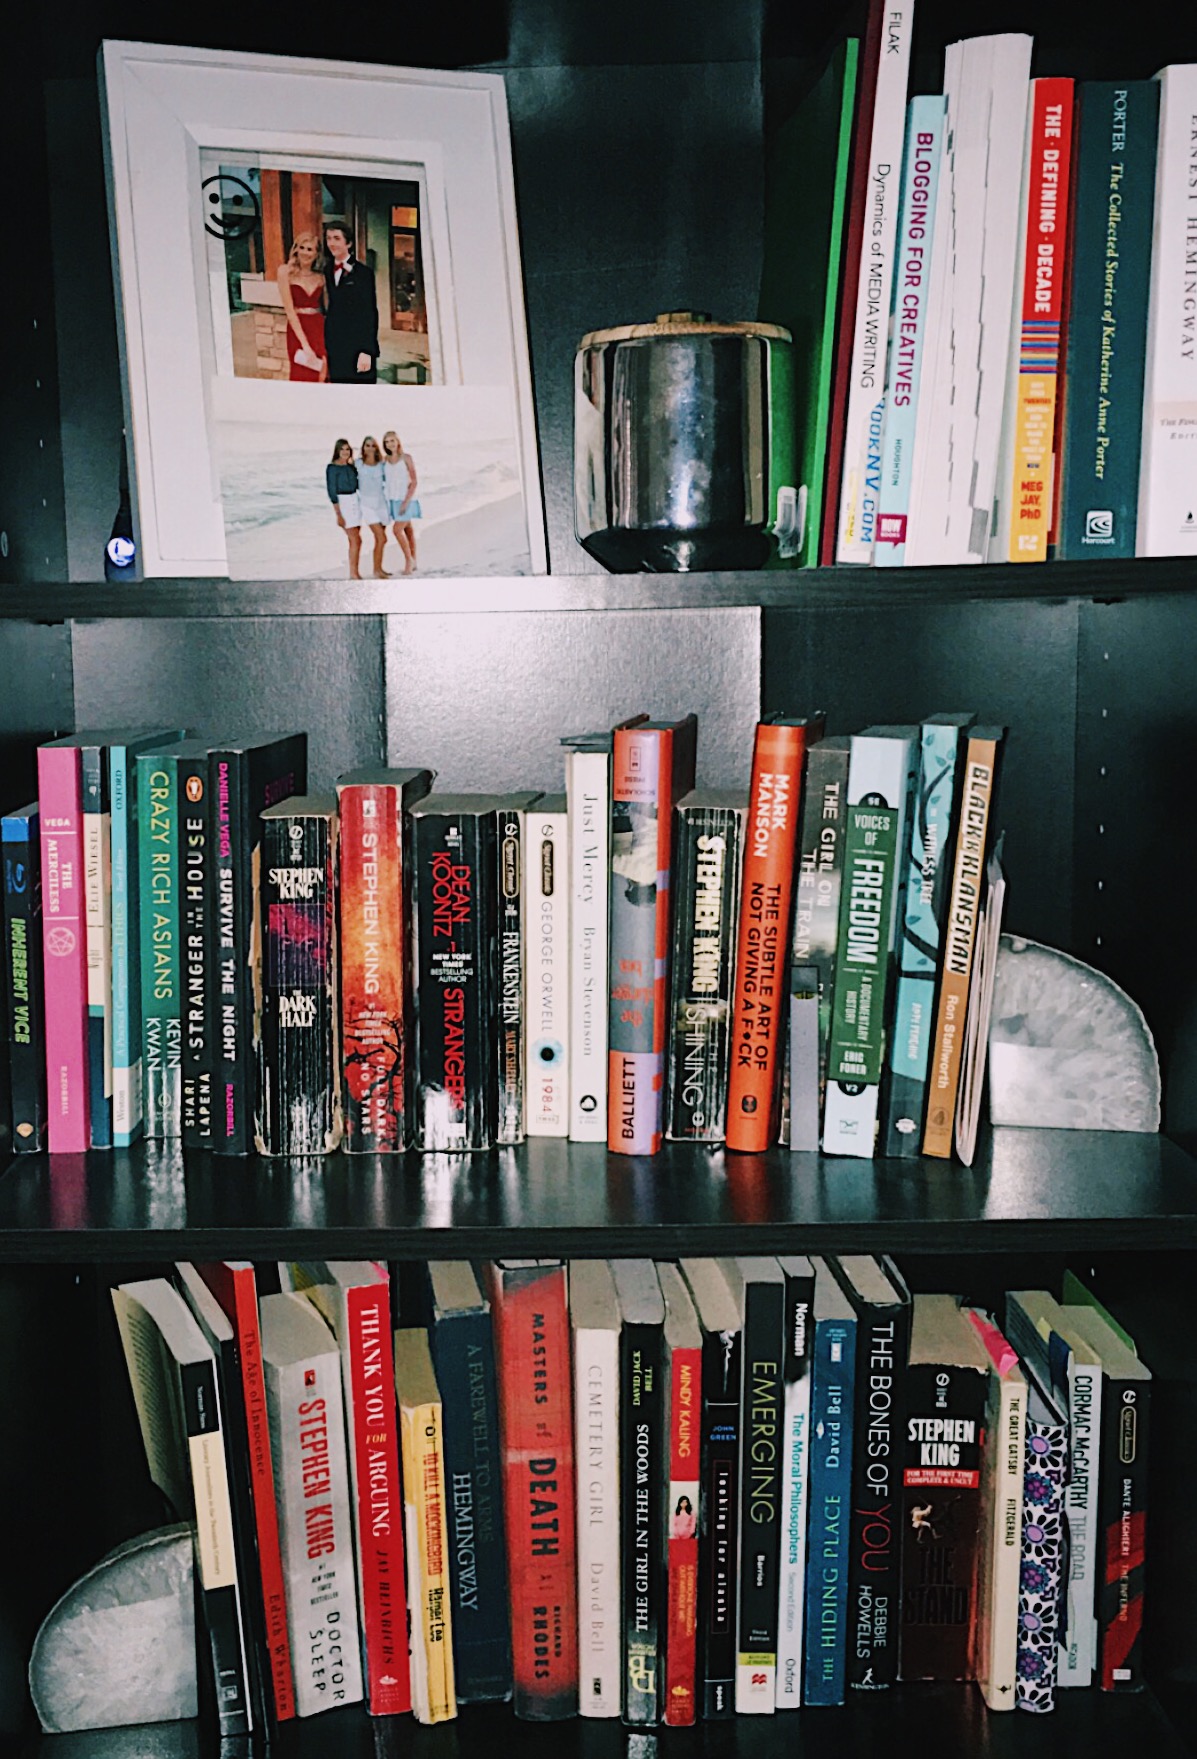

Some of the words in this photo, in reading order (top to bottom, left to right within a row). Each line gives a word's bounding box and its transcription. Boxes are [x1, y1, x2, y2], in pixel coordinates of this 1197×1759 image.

[887, 11, 902, 55] FILAK
[1044, 105, 1062, 138] THE
[1112, 90, 1127, 152] PORTER
[909, 132, 934, 240] BLOGGING
[1039, 149, 1060, 234] DEFINING
[1110, 163, 1123, 189] The
[872, 163, 891, 237] Dynamics
[1106, 191, 1121, 253] Collected
[871, 243, 881, 259] of
[903, 249, 923, 287] FOR
[866, 263, 884, 315] MEDIA
[1034, 244, 1055, 313] DECADE
[1103, 256, 1119, 303] Stories
[1102, 309, 1114, 323] of
[860, 316, 880, 389] WRITING
[895, 294, 919, 407] CREATIVES
[1099, 326, 1116, 394] Katherine
[1097, 397, 1111, 432] Anne
[891, 439, 902, 486] HOUGHTON
[1094, 437, 1110, 479] Porter
[1021, 481, 1043, 492] MEG
[1020, 508, 1041, 520] PhD
[115, 769, 123, 811] OXFORD
[150, 771, 170, 845] CRAZY
[218, 762, 229, 822] DANIELLE
[771, 774, 790, 830] MARK
[823, 782, 840, 820] THE
[44, 818, 70, 827] VEGA
[754, 773, 774, 858] MANSON
[854, 814, 891, 829] VOICES
[187, 818, 205, 900] HOUSE
[219, 824, 230, 858] VEGA
[817, 828, 837, 873] GIRL
[864, 832, 878, 846] OF
[47, 839, 60, 913] MERCILESS
[62, 862, 73, 889] THE
[151, 853, 171, 904] RICH
[268, 868, 324, 885] STEPHEN
[279, 883, 314, 899] KING
[362, 833, 379, 935] STEPHEN
[800, 849, 817, 888] THE
[219, 868, 234, 949] SURVIVE
[431, 852, 452, 937] KOONTZ
[451, 865, 470, 923] DEAN
[766, 885, 781, 920] THE
[817, 879, 832, 907] ON
[846, 858, 886, 964] FREEDOM
[187, 911, 194, 924] IN
[195, 906, 204, 929] THE
[541, 901, 553, 965] GEORGE
[794, 896, 816, 960] TRAIN
[10, 917, 29, 1002] INHERENT
[152, 913, 173, 999] ASIANS
[221, 958, 236, 995] THE
[364, 943, 380, 995] KING
[433, 953, 449, 961] NEW
[451, 953, 472, 961] YORK
[442, 960, 464, 968] TIMES
[760, 929, 778, 996] SUBTLE
[187, 935, 205, 1048] STRANGER
[279, 996, 317, 1013] DARK
[541, 973, 553, 1031] ORWELL
[844, 990, 857, 1024] HISTORY
[857, 983, 873, 1041] DOCUMENTARY
[947, 994, 959, 1020] Ron
[14, 1005, 30, 1044] VICE
[222, 1005, 236, 1062] NIGHT
[281, 1011, 316, 1028] HALF
[758, 1003, 771, 1038] ART
[146, 1017, 162, 1071] KWAN
[166, 1018, 182, 1069] KEVIN
[682, 1007, 706, 1106] SHINING
[754, 1048, 768, 1072] OF
[844, 1050, 864, 1063] ERIC
[937, 1023, 956, 1089] Stallworth
[840, 1062, 867, 1076] FONER
[184, 1078, 195, 1127] SHARI
[199, 1073, 211, 1136] LAPENA
[226, 1083, 234, 1137] RAZORBILL
[541, 1078, 553, 1112] 1984
[622, 1058, 636, 1139] BALLIETT
[244, 1331, 255, 1358] The
[361, 1304, 382, 1380] THANK
[794, 1303, 808, 1357] Norman
[870, 1321, 894, 1369] THE
[246, 1362, 257, 1385] Age
[531, 1313, 548, 1405] MASTERS
[632, 1350, 643, 1375] JACK
[644, 1366, 653, 1392] BELL
[250, 1389, 257, 1403] of
[364, 1385, 384, 1427] YOU
[632, 1374, 641, 1406] DAVID
[827, 1386, 842, 1414] Bell
[1010, 1398, 1020, 1413] THE
[1073, 1375, 1093, 1434] CORMAC
[366, 1433, 387, 1445] FOR
[868, 1376, 892, 1457] BONES
[908, 1418, 975, 1444] STEPHEN
[1009, 1416, 1020, 1442] GREAT
[252, 1408, 265, 1476] Innocence
[298, 1398, 331, 1499] STEPHEN
[636, 1424, 649, 1485] WOODS
[750, 1362, 777, 1524] EMERGING
[826, 1422, 840, 1468] David
[920, 1443, 960, 1467] KING
[1008, 1443, 1018, 1475] GATSBY
[368, 1449, 391, 1537] ARGUING
[866, 1465, 889, 1497] OF
[907, 1470, 920, 1478] FOR
[921, 1470, 935, 1478] THE
[936, 1470, 955, 1479] FIRST
[1070, 1438, 1091, 1510] McCARTHY
[1123, 1479, 1132, 1507] DANTE
[528, 1457, 559, 1556] DEATH
[636, 1489, 649, 1525] THE
[716, 1472, 729, 1530] looking
[1006, 1498, 1016, 1546] FITZGERALD
[305, 1504, 336, 1559] KING
[452, 1472, 478, 1611] HEMINGWAY
[636, 1529, 648, 1549] IN
[824, 1495, 840, 1558] PLACE
[855, 1504, 892, 1571] YOU
[1070, 1516, 1087, 1540] THE
[1121, 1511, 1131, 1556] ALIGHIERI
[376, 1550, 390, 1575] JAY
[636, 1553, 648, 1592] GIRL
[718, 1540, 728, 1563] for
[756, 1555, 765, 1587] Barrios
[1071, 1544, 1086, 1580] ROAD
[1120, 1565, 1128, 1584] THE
[269, 1594, 285, 1637] Edith
[636, 1597, 649, 1632] THE
[717, 1573, 727, 1622] alaska
[821, 1568, 838, 1647] HIDING
[1119, 1588, 1128, 1622] INFERNO
[379, 1581, 394, 1665] HEINRICHS
[532, 1606, 549, 1679] RHODES
[553, 1605, 562, 1658] RICHARD
[857, 1585, 872, 1659] HOWELLS
[873, 1597, 888, 1648] DEBBIE
[274, 1645, 287, 1711] Wharton
[309, 1630, 327, 1691] SLEEP
[326, 1611, 345, 1701] DOCTOR
[785, 1659, 796, 1693] Oxford
[823, 1658, 834, 1681] THE
[716, 1685, 724, 1711] speak
